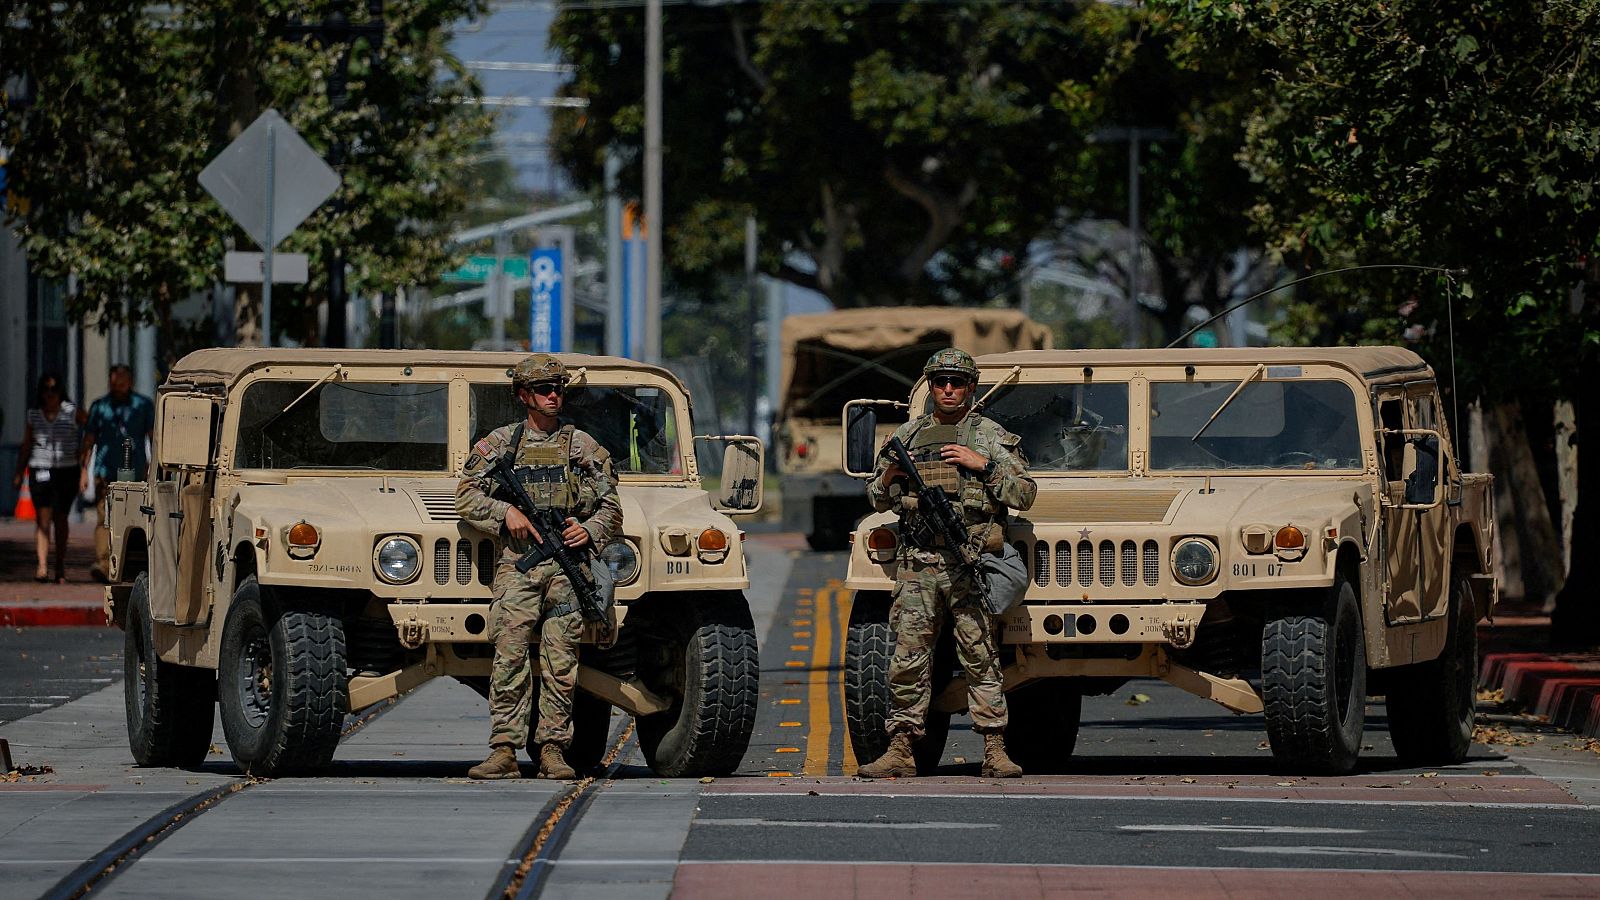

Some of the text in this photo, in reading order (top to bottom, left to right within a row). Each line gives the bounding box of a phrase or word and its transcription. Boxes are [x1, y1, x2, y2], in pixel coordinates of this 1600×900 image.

[1233, 563, 1283, 576] 801 07
[1012, 616, 1025, 624] TIE
[1149, 616, 1160, 624] TIE
